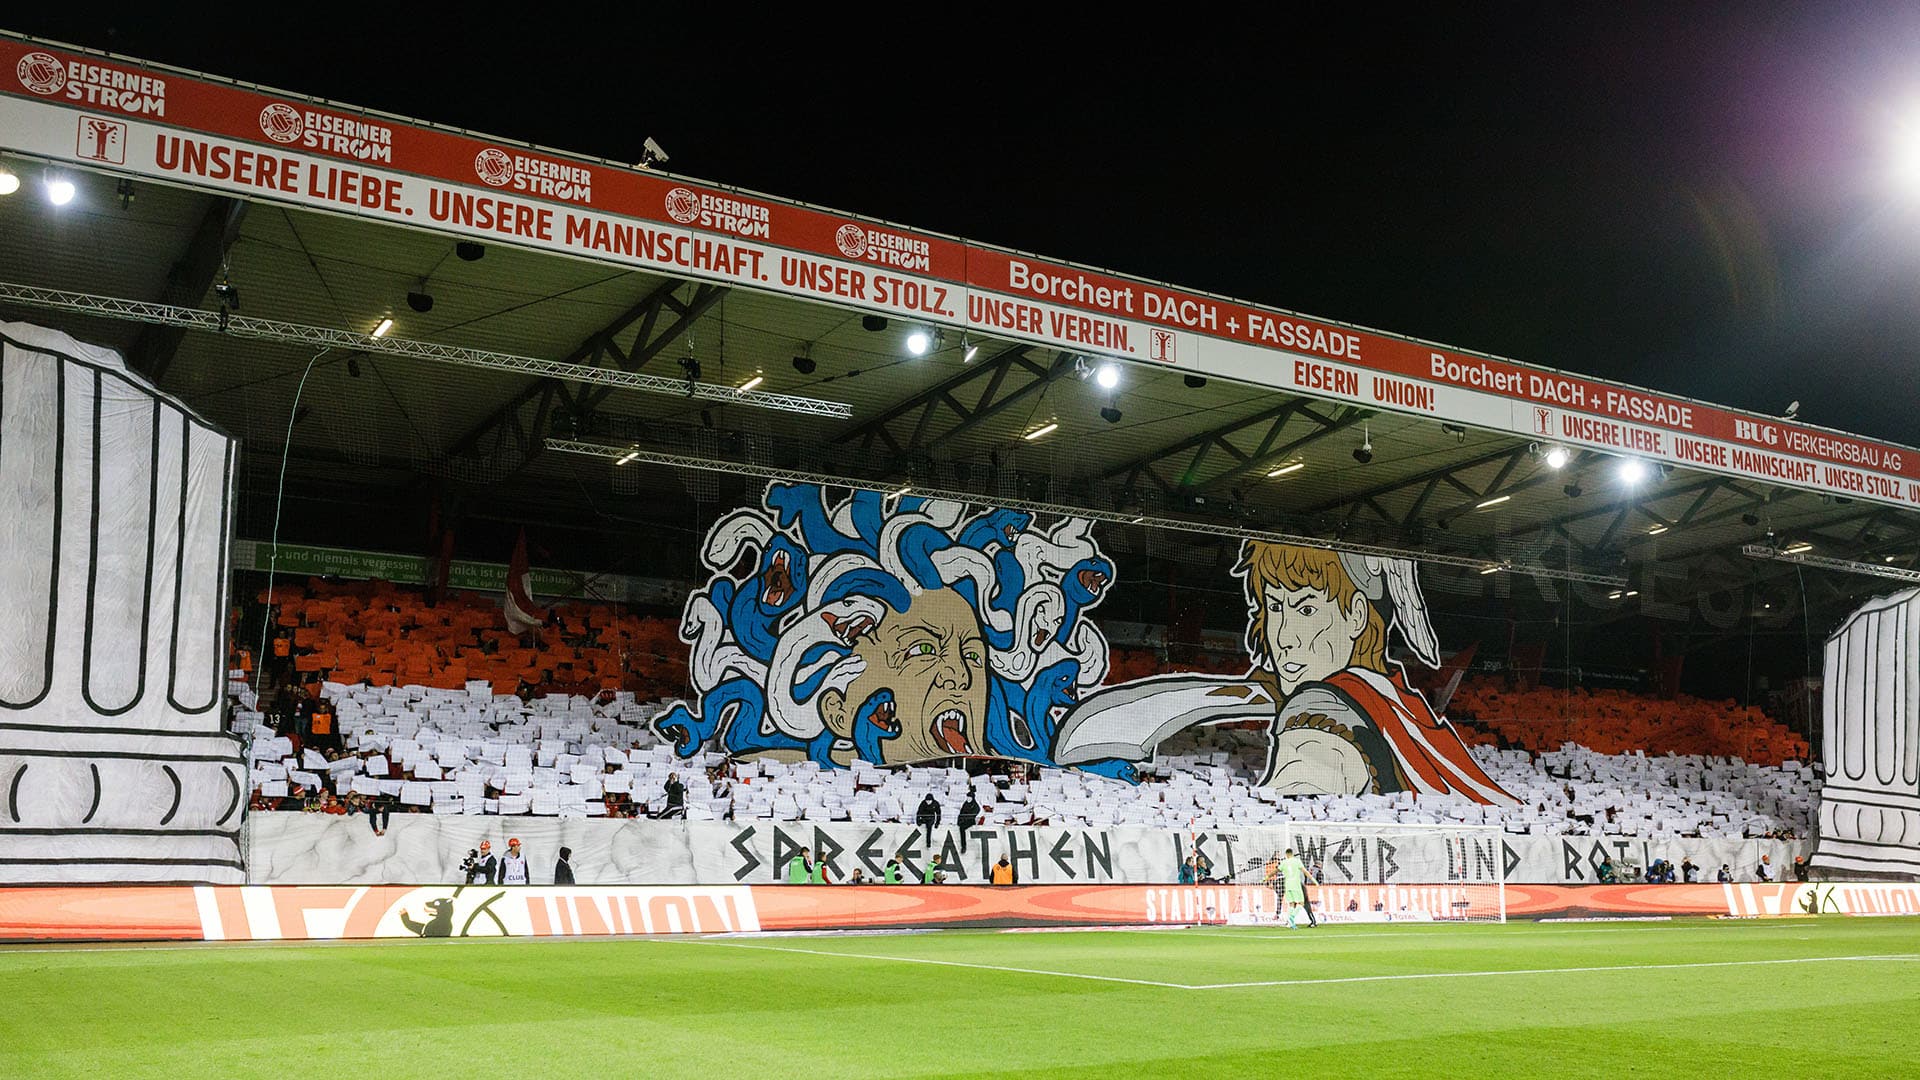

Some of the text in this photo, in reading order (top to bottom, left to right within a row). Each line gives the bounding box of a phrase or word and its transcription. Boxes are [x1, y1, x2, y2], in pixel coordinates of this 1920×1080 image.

[69, 61, 166, 97] EISERNER
[66, 81, 165, 117] STROM
[304, 111, 392, 147] EISERNER
[304, 129, 392, 164] STROM
[513, 172, 592, 203] STROM
[514, 156, 592, 187] EISERNER
[700, 210, 770, 240] STROM
[701, 193, 770, 223] EISERNER
[155, 134, 1135, 353] UNSERE LIEBE. UNSERE MANNSCHAFT. UNSER STOLZ. UNSER VEREIN.
[867, 245, 930, 272] STROM
[868, 230, 930, 256] EISERNER
[1009, 260, 1134, 313] Borchert
[1143, 291, 1218, 331] DACH
[1248, 312, 1362, 361] FASSADE
[1294, 359, 1435, 411] EISERN UNION!
[1430, 353, 1523, 394] Borchert
[1530, 375, 1585, 407] DACH
[1606, 391, 1693, 429] FASSADE
[1562, 414, 1620, 447] UNSERE
[1622, 426, 1667, 456] LIEBE.
[1674, 437, 1727, 467] UNSERE
[1732, 448, 1821, 485] MANNSCHAFT.
[1824, 466, 1864, 493] UNSER
[1866, 475, 1905, 501] STOLZ.
[1734, 418, 1902, 471] BUG VERKEHRSBAU AG
[313, 551, 358, 566] niemals
[480, 566, 494, 578] ist
[269, 713, 281, 724] 13
[730, 825, 1113, 881] SPREEATHEN
[1445, 837, 1522, 881] UND
[1145, 888, 1230, 922] STADION
